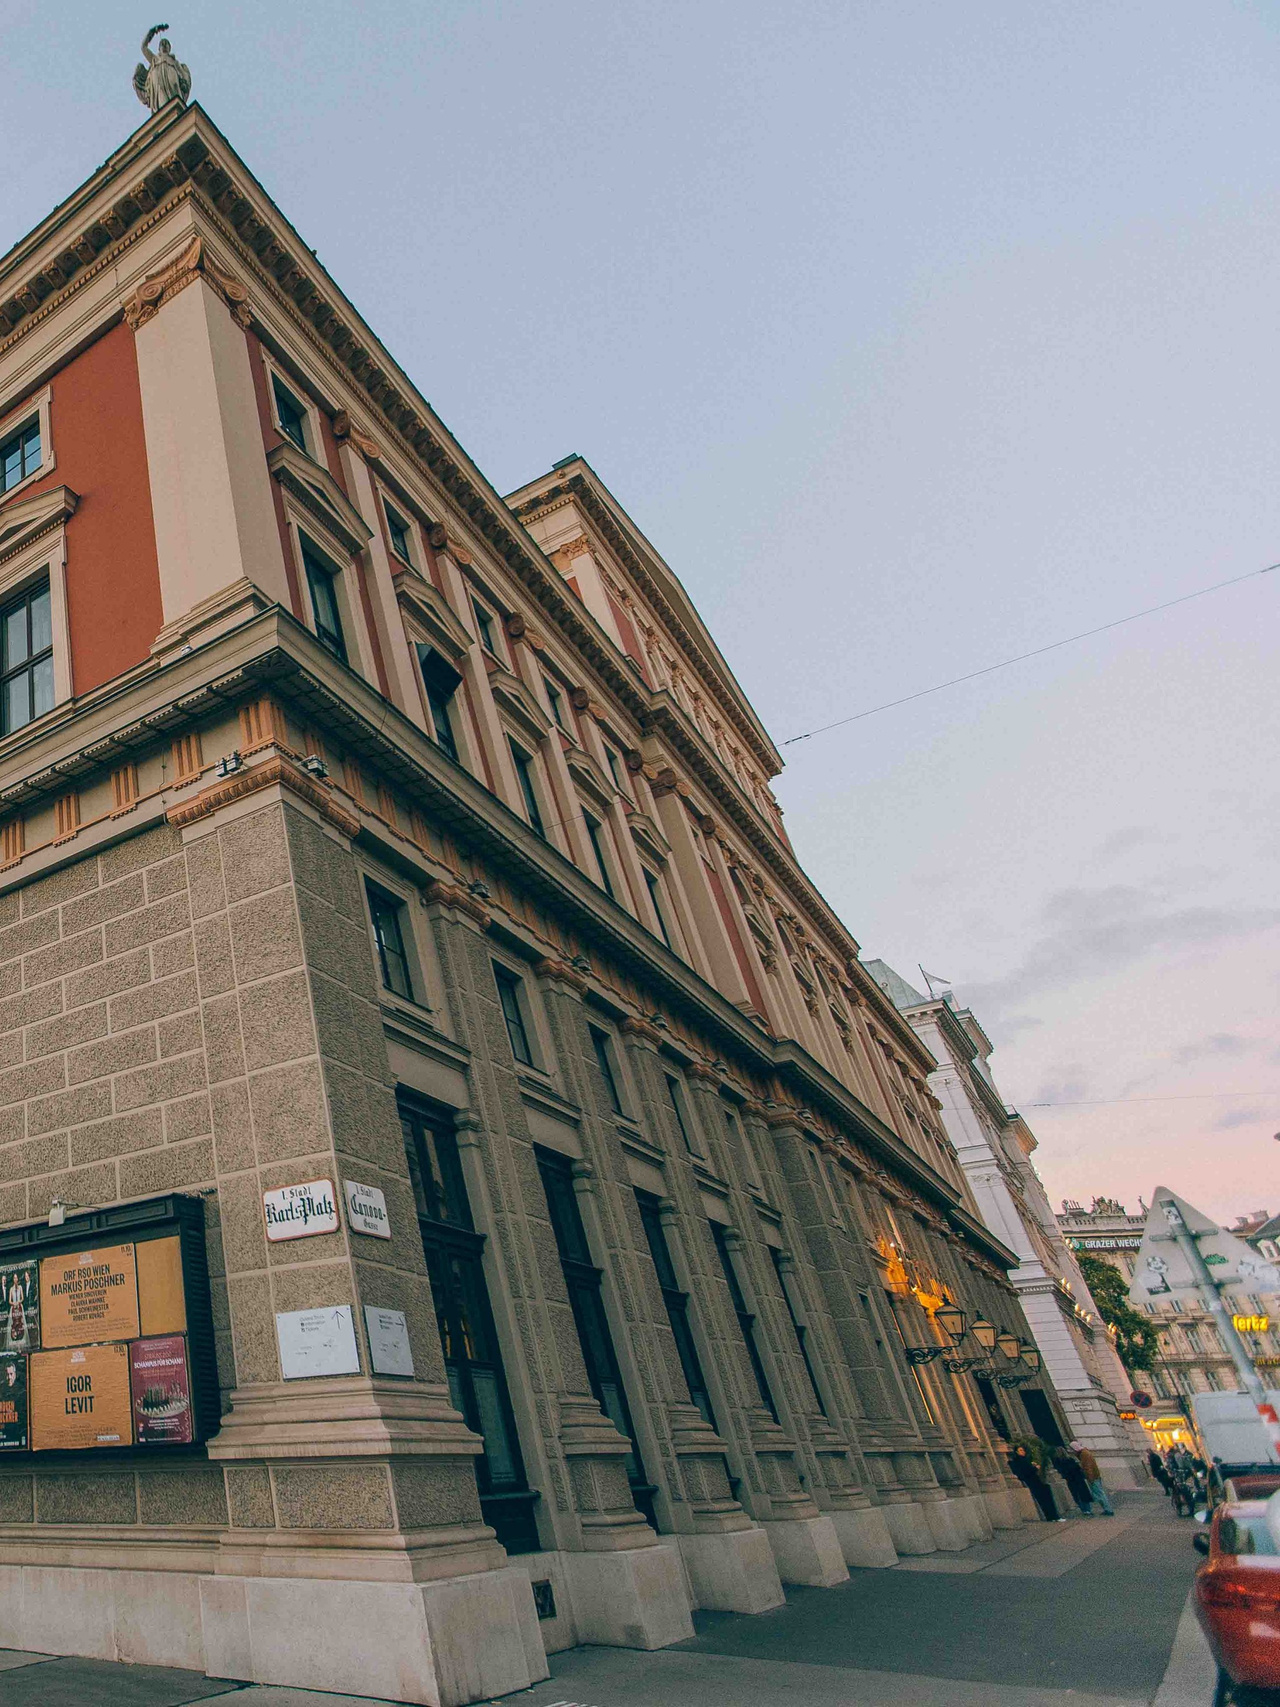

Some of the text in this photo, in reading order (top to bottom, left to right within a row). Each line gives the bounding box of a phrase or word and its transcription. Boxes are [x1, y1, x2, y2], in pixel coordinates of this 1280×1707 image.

[1085, 1239, 1116, 1249] GRAZER
[63, 1263, 110, 1282] ORF RSO WIEN
[51, 1273, 125, 1297] MARKUS POSCHNER
[66, 1375, 92, 1393] IGOR
[65, 1396, 95, 1415] LEVIT
